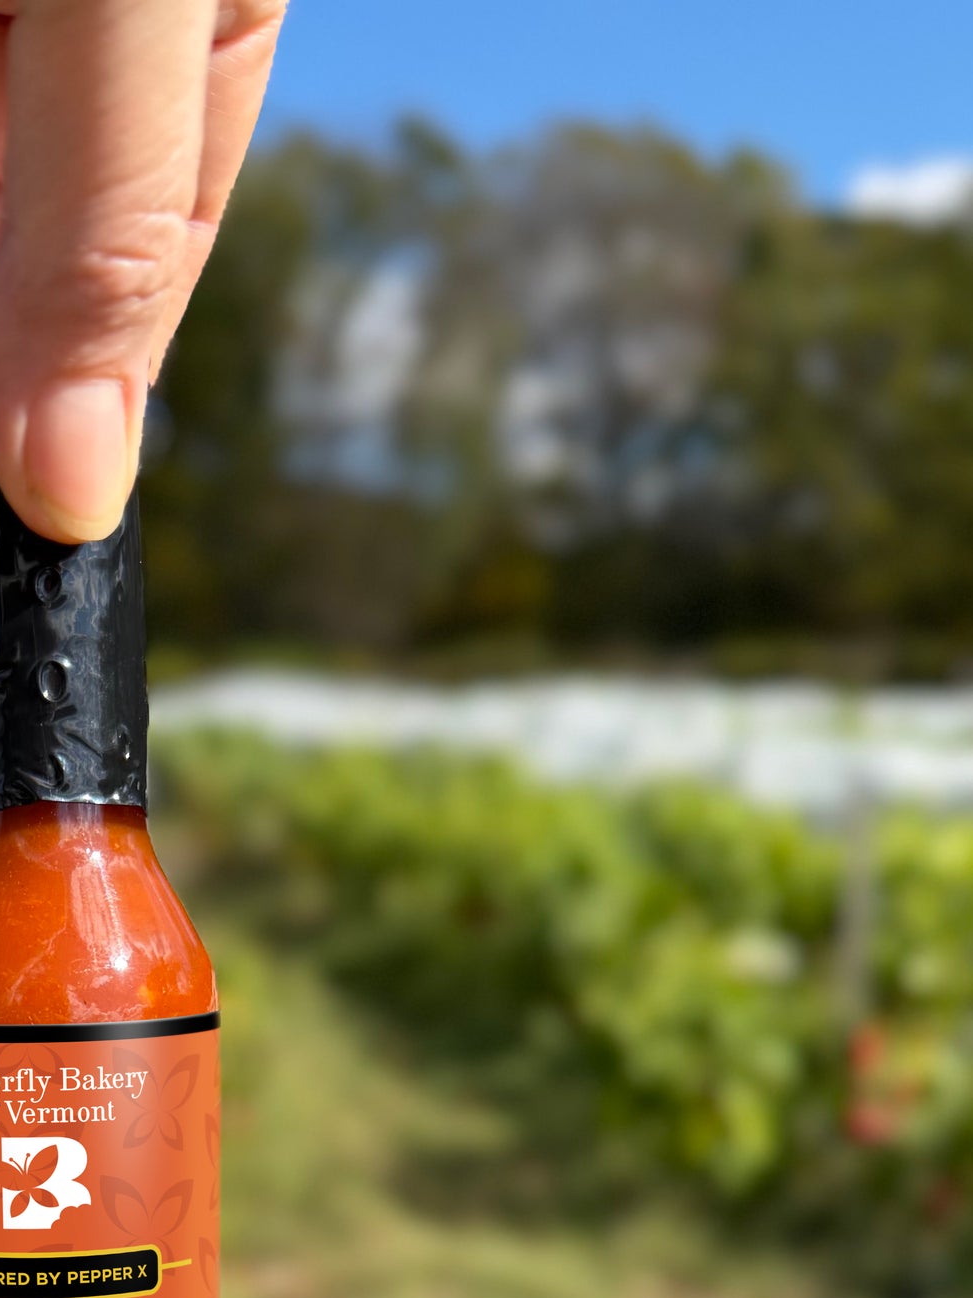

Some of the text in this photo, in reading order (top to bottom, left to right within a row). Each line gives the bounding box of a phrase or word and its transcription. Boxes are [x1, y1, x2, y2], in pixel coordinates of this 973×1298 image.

[59, 1065, 149, 1099] Bakery
[3, 1100, 117, 1125] Vermont
[36, 1271, 62, 1286] BY
[67, 1266, 133, 1285] PEPPER
[137, 1264, 148, 1278] X
